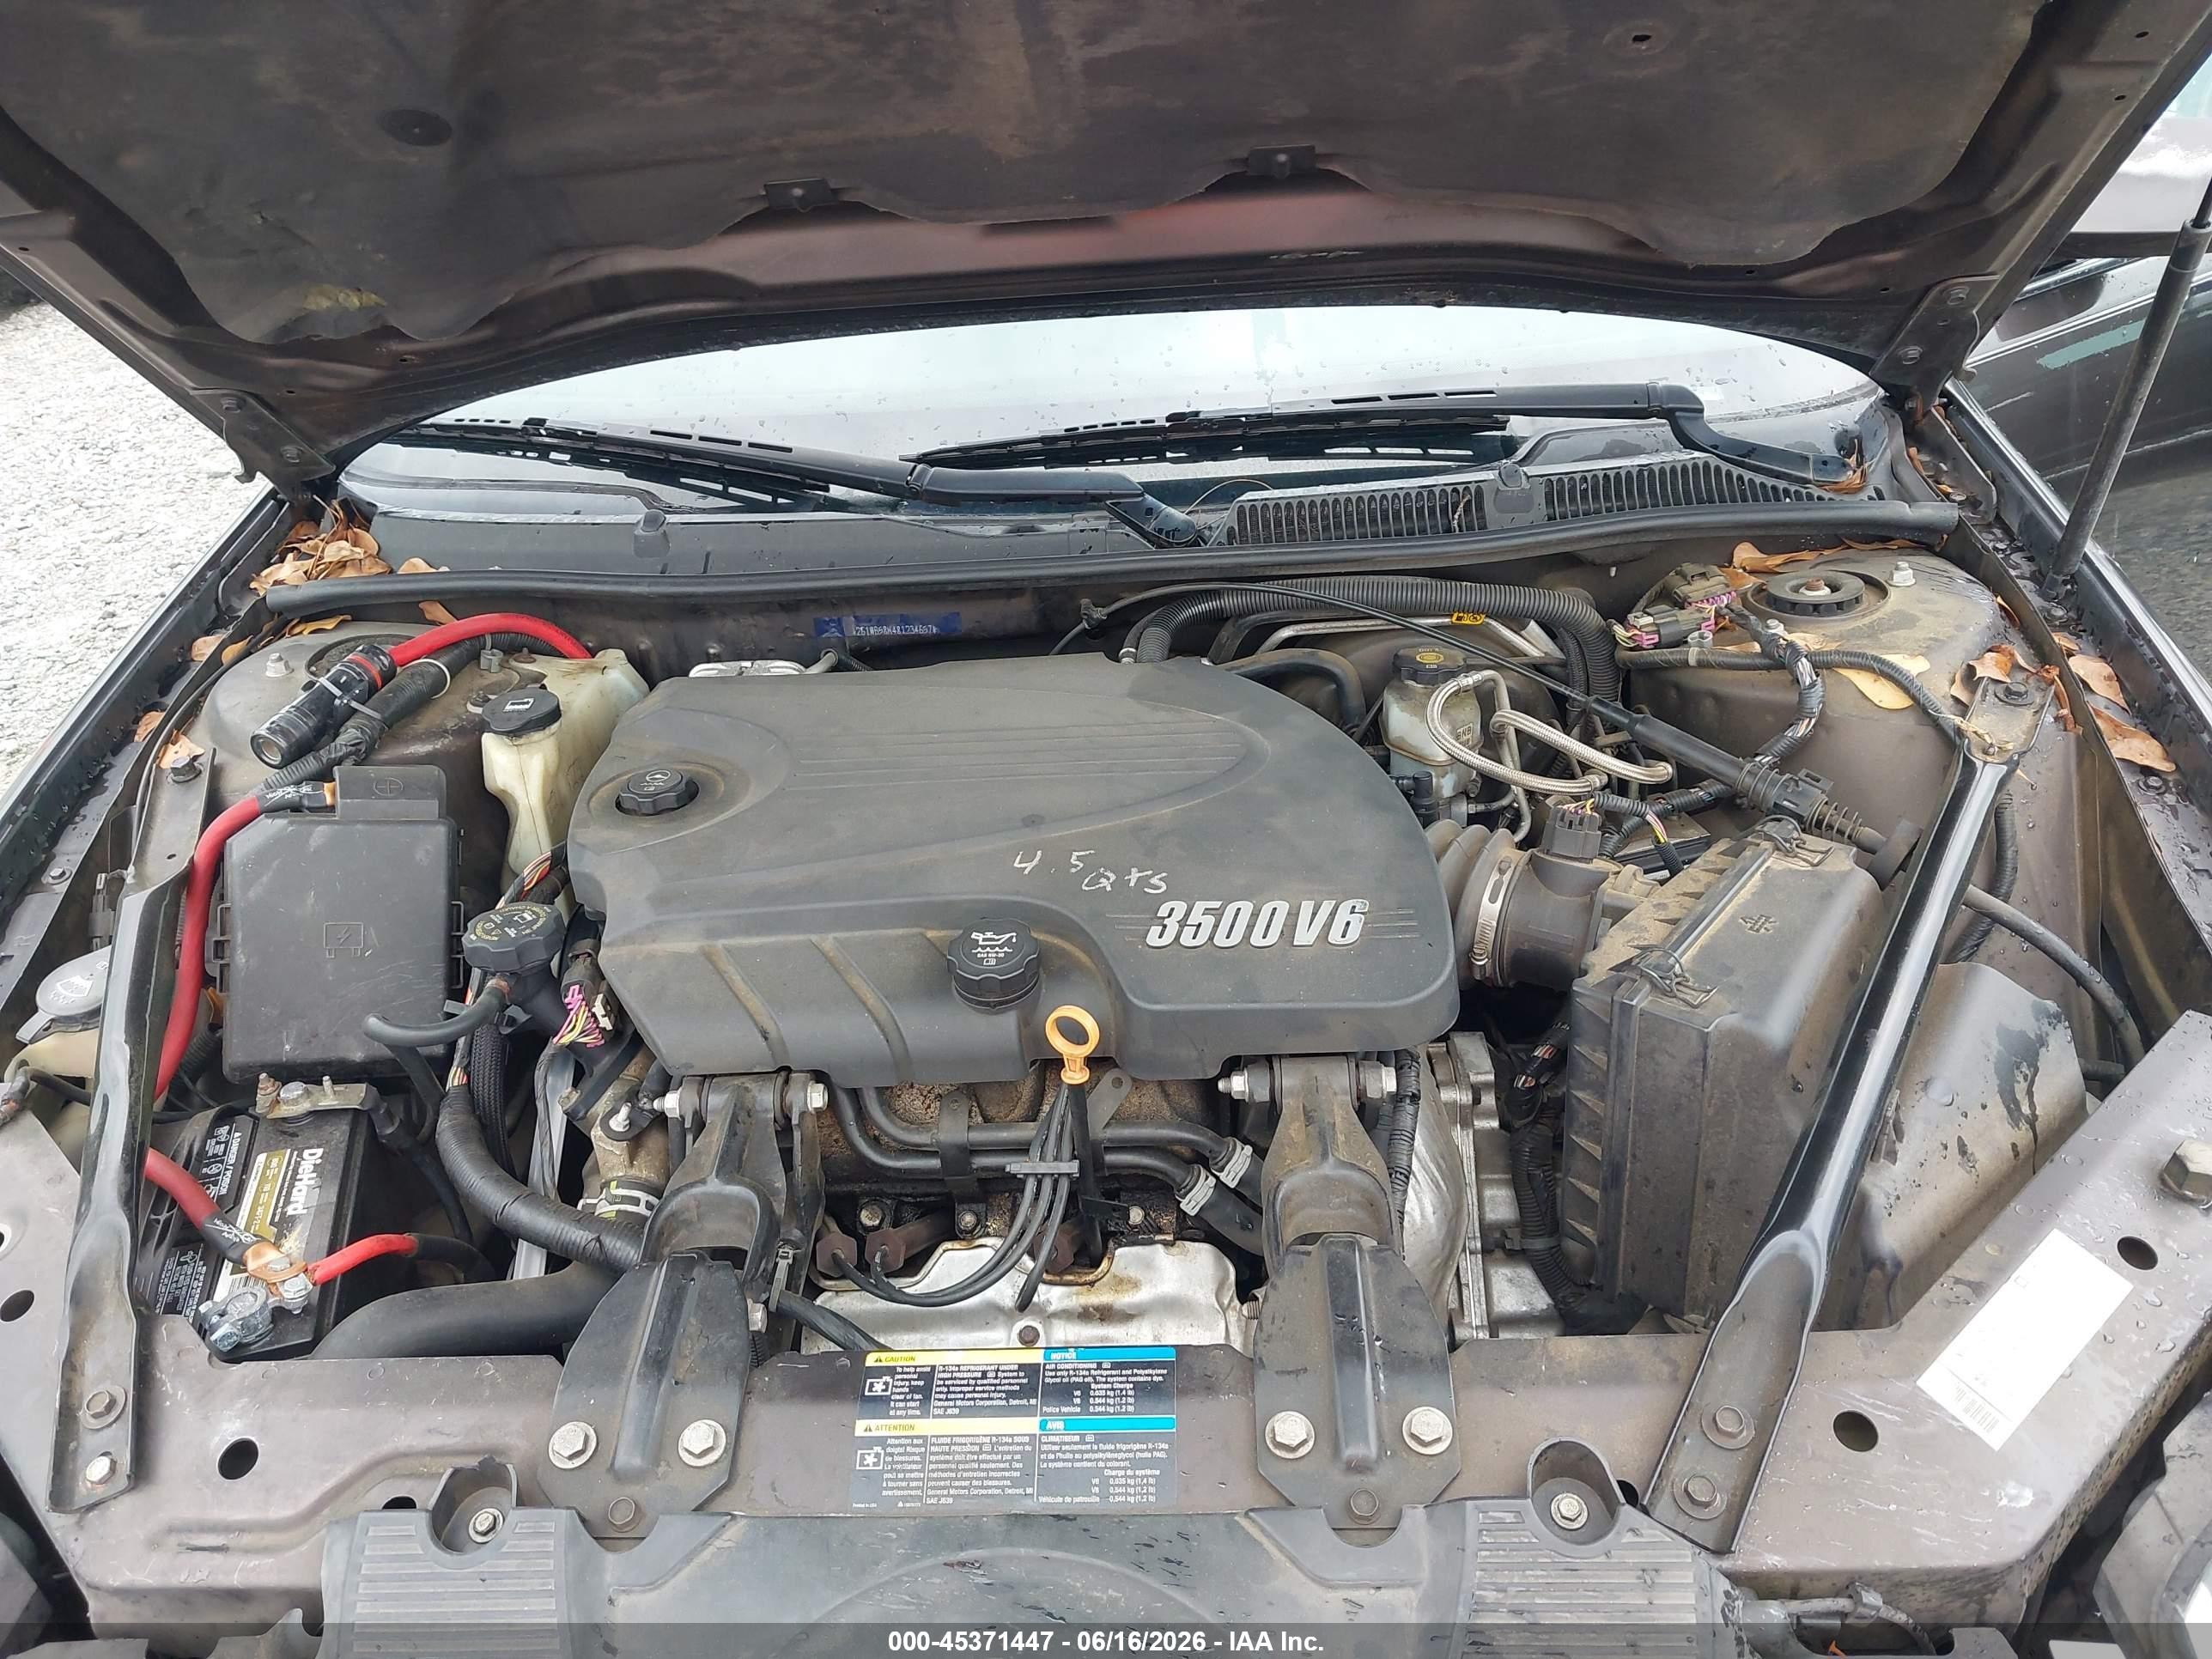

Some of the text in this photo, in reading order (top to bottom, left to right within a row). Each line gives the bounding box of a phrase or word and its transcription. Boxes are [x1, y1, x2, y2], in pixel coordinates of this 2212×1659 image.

[1146, 898, 1370, 950] 3500 V6
[227, 1138, 241, 1164] DANGER
[286, 1147, 324, 1216] DieHard
[1106, 1396, 1115, 1405] kg
[1106, 1405, 1115, 1413] kg
[1127, 1405, 1135, 1413] lb)
[1104, 1468, 1125, 1477] Charge
[1135, 1468, 1160, 1477] système
[1127, 1477, 1134, 1486] kg
[969, 1487, 1004, 1496] Corporation,
